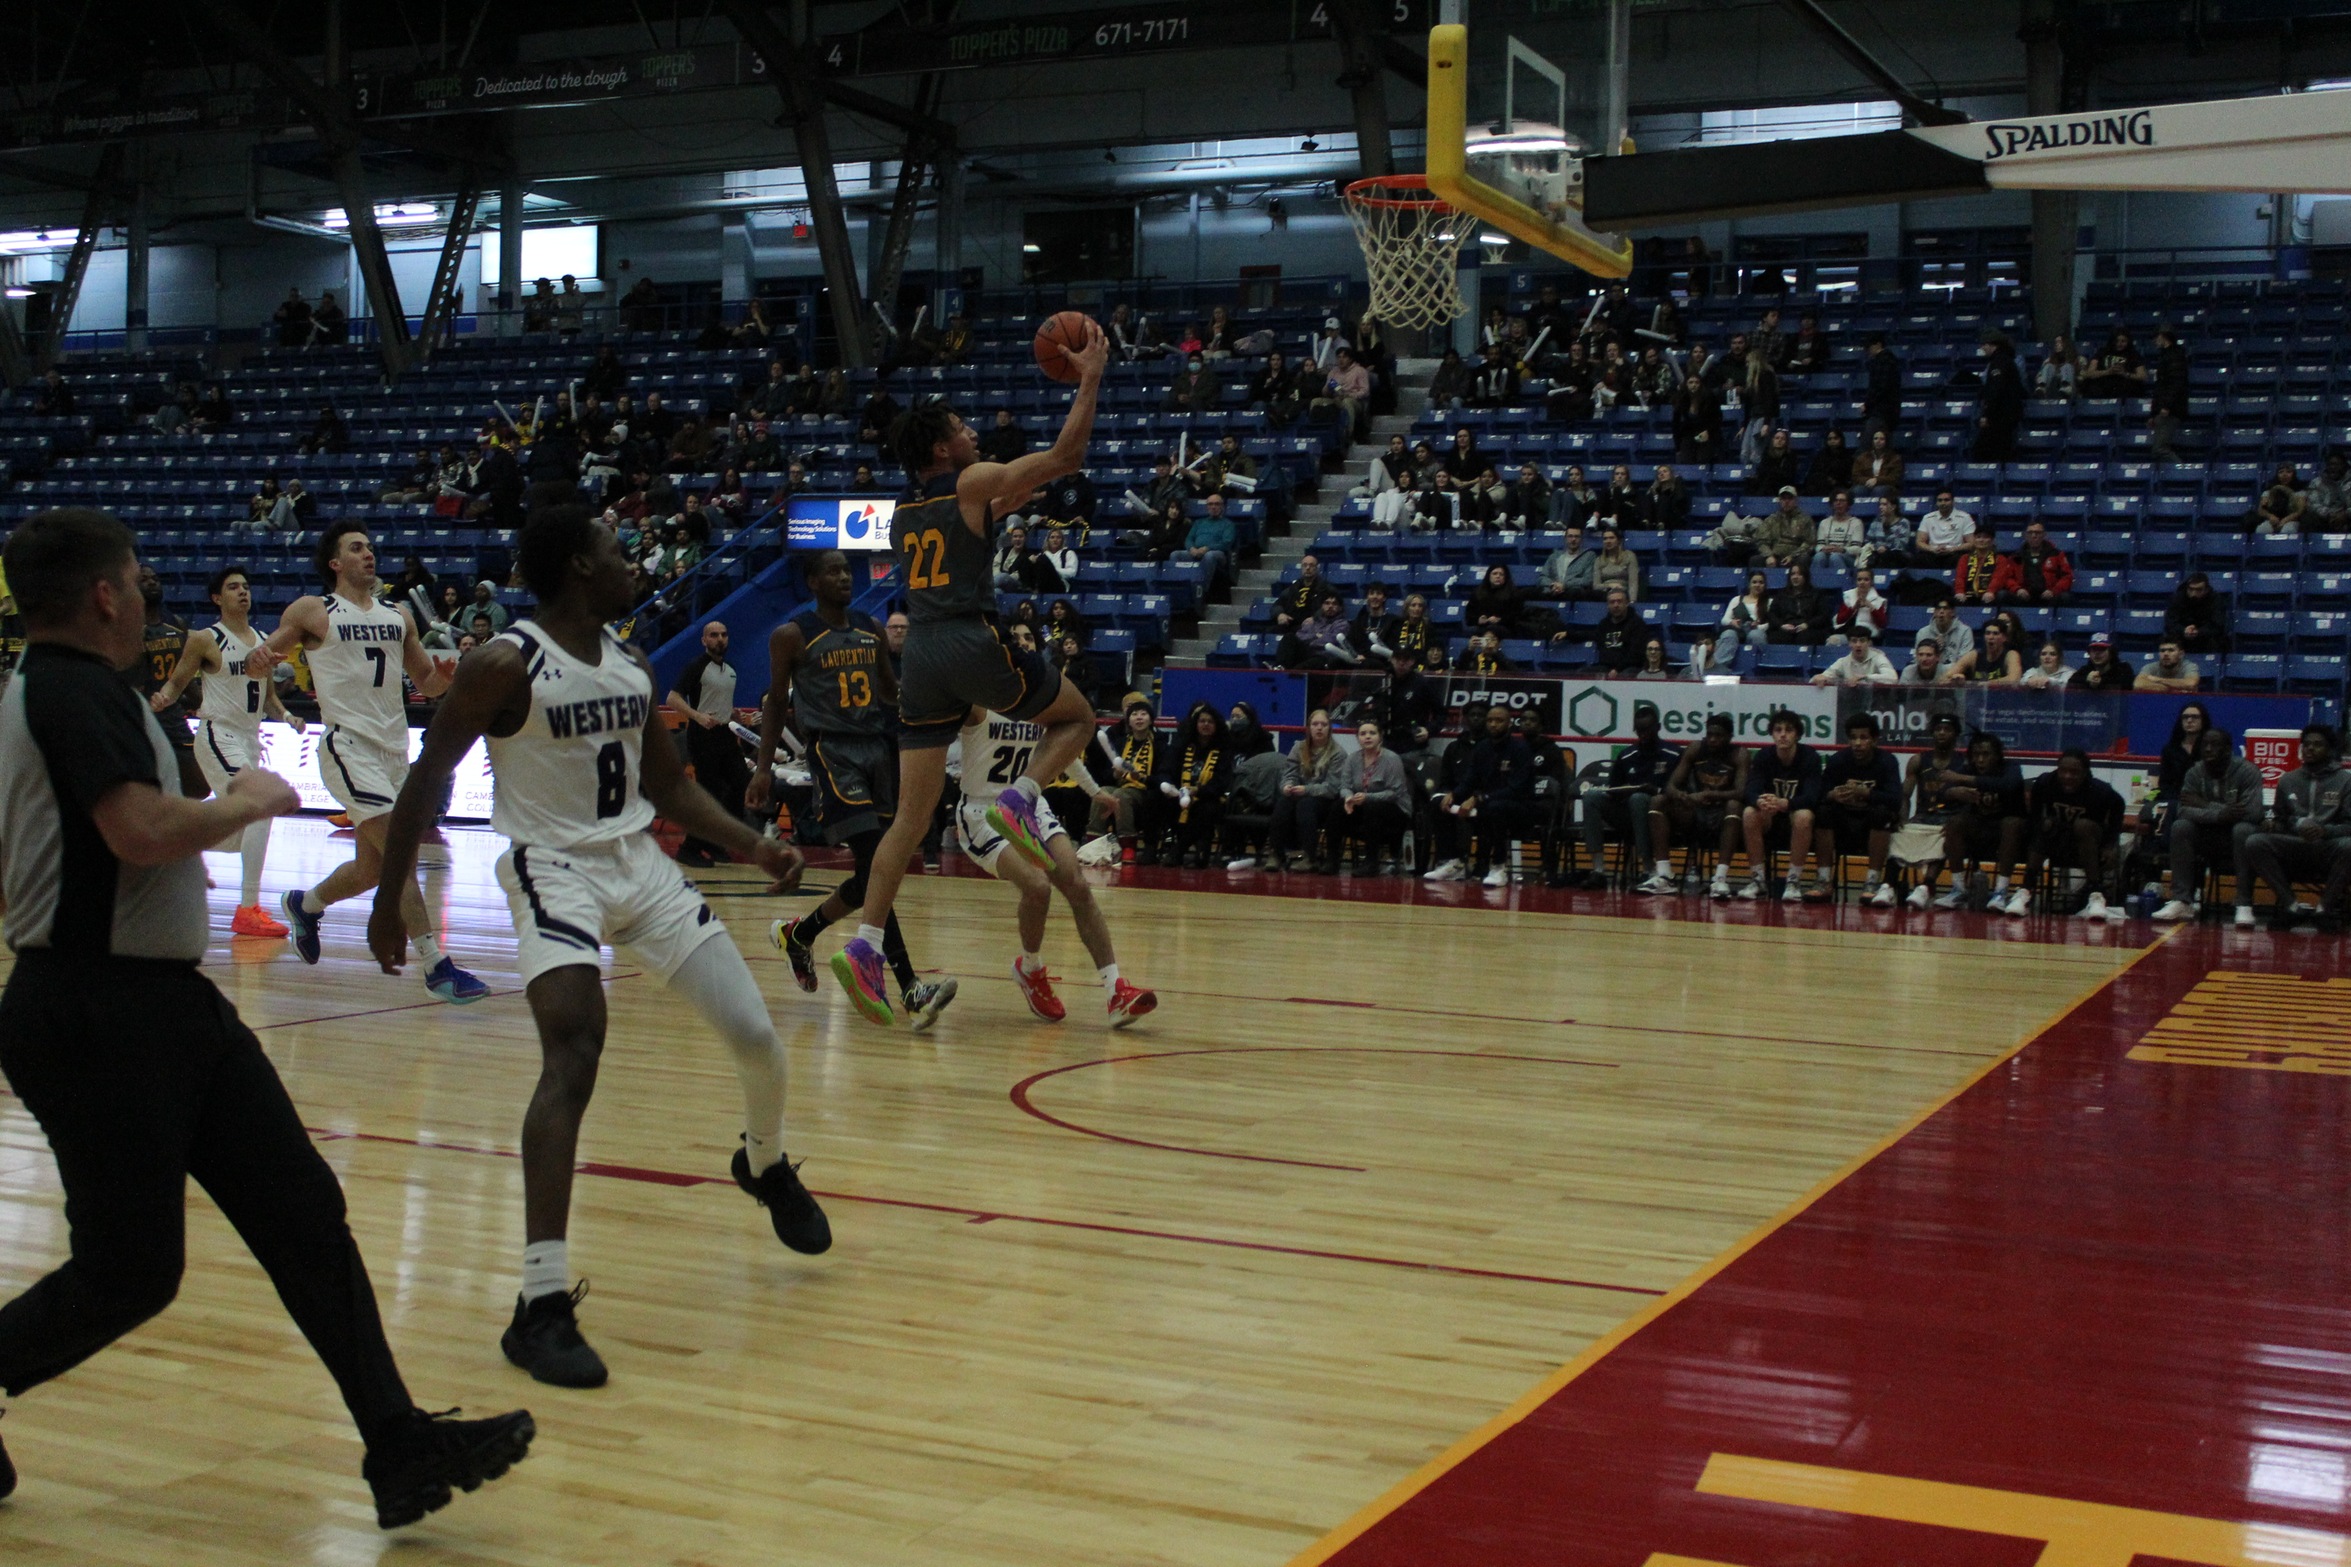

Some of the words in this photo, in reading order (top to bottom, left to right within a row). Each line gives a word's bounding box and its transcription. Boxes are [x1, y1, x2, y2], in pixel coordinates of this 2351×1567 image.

[1310, 2, 1329, 28] 4
[1393, 1, 1409, 22] 5
[950, 24, 1019, 60] TOPPER'S
[1025, 26, 1068, 53] PIZZA
[1095, 18, 1188, 46] 671-7171
[641, 50, 696, 79] TOPPER'S
[827, 44, 842, 68] 4
[473, 75, 543, 98] Dedicated
[545, 73, 559, 90] to
[561, 69, 581, 88] the
[584, 66, 628, 94] dough
[656, 77, 678, 88] PIZZA
[355, 88, 368, 111] 3
[1986, 110, 2152, 159] SPALDING
[1517, 274, 1526, 290] 5
[801, 302, 808, 314] 3
[903, 528, 950, 590] 22
[337, 624, 402, 642] WESTERN
[365, 647, 386, 687] 7
[821, 648, 877, 669] LAURENTIAN
[247, 681, 260, 713] 6
[838, 670, 872, 708] 13
[1451, 691, 1548, 709] DEPOT
[1866, 705, 1927, 731] mla
[1887, 734, 1912, 742] LAW
[2254, 742, 2289, 757] BIO
[987, 746, 1032, 784] 20
[2254, 757, 2288, 765] STEEL
[597, 740, 626, 821] 8
